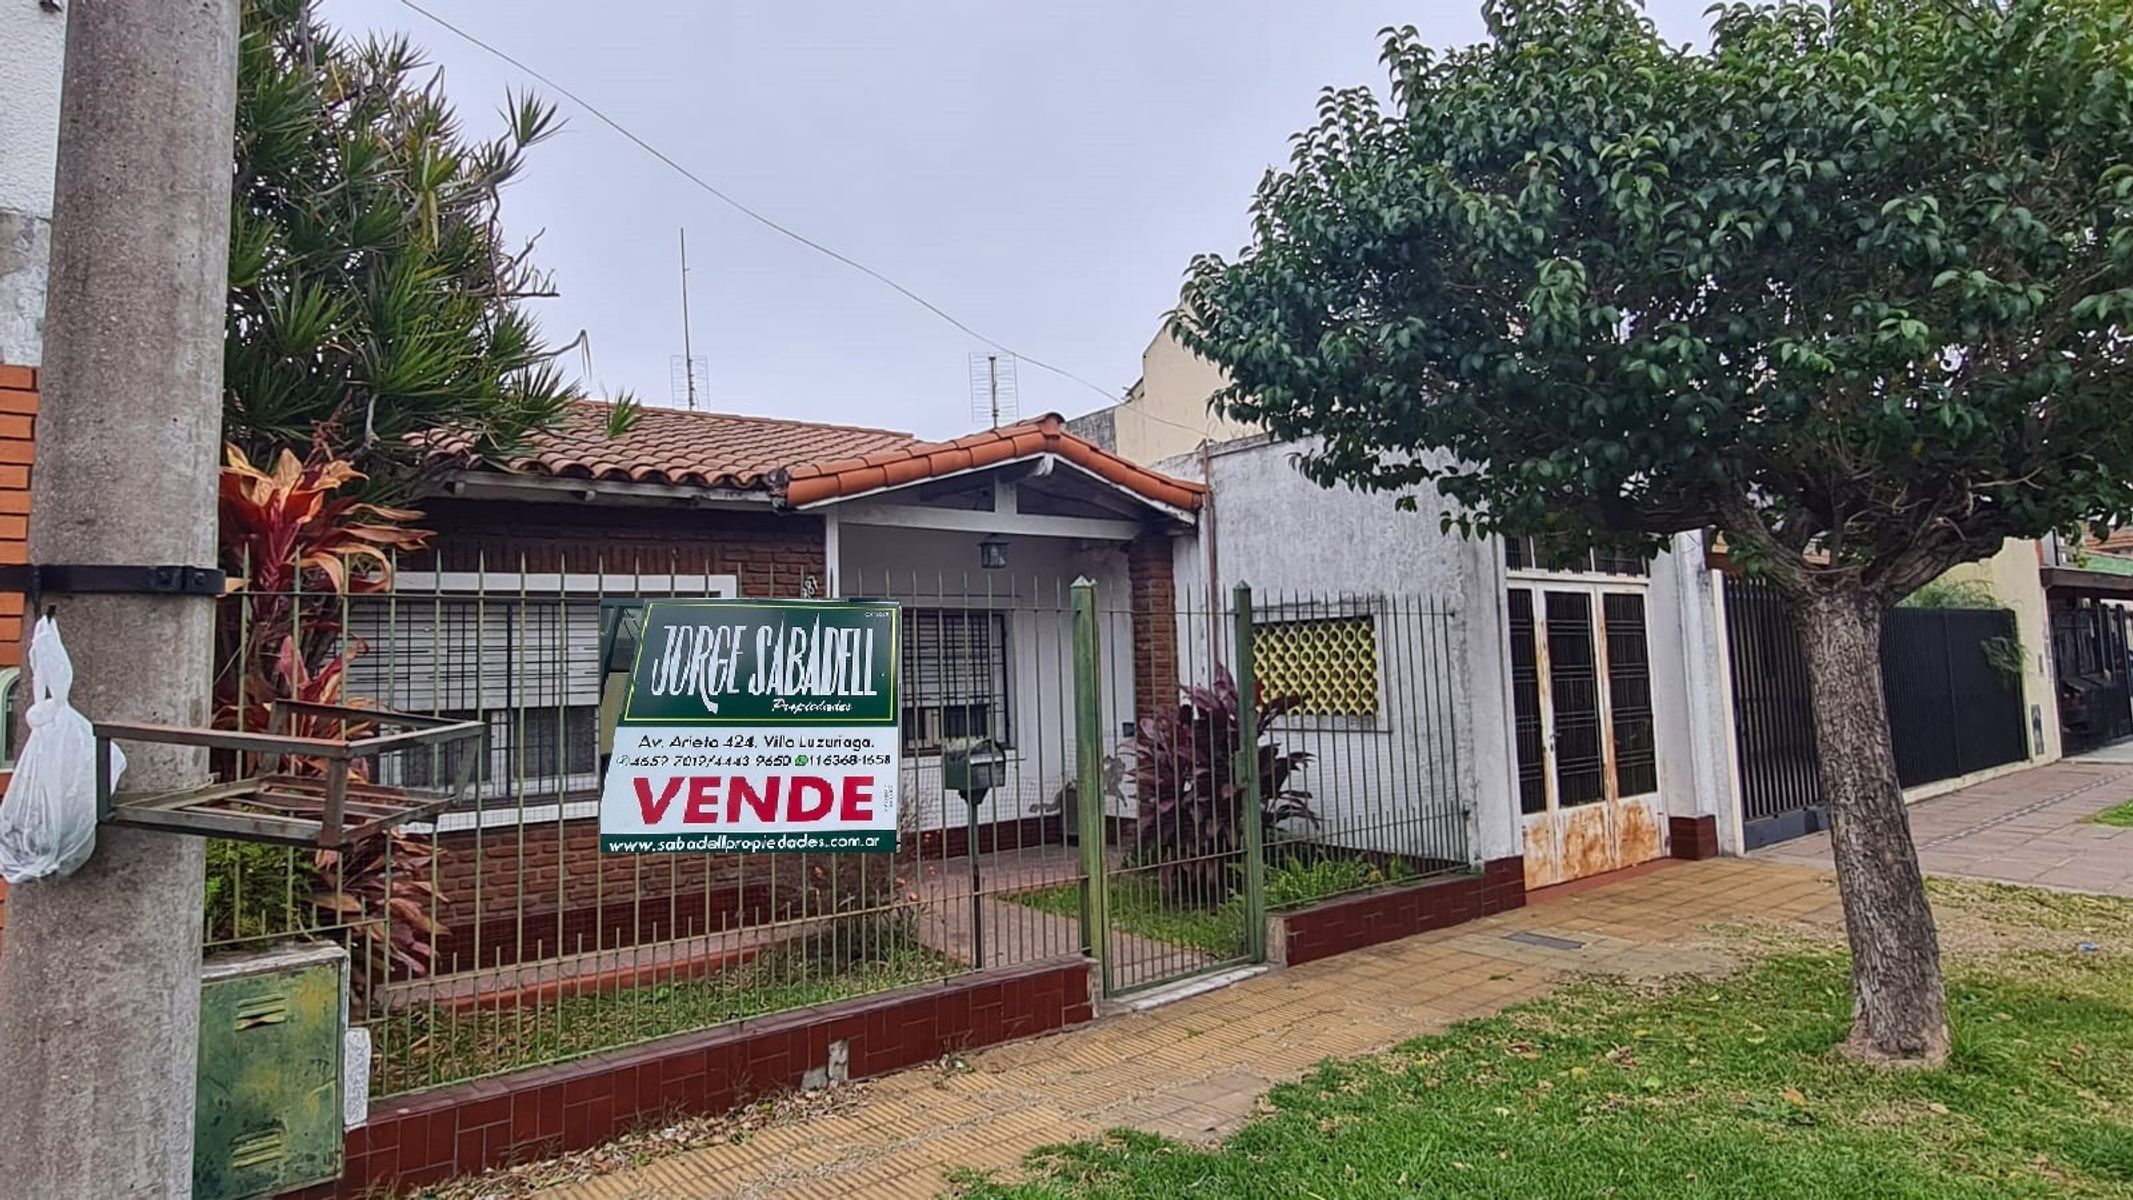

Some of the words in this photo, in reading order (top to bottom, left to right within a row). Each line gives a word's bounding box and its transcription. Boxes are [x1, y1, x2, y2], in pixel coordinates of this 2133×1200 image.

[651, 625, 747, 714] JORGE
[748, 612, 877, 696] SABADELL
[771, 699, 852, 714] Propiedades
[638, 734, 664, 748] Av.
[669, 735, 719, 748] Arieta
[763, 735, 795, 748] Villa
[799, 735, 875, 751] Luzuriaga.
[633, 775, 875, 825] VENDE
[609, 834, 880, 853] www.sabadellpropiedades.com.ar
